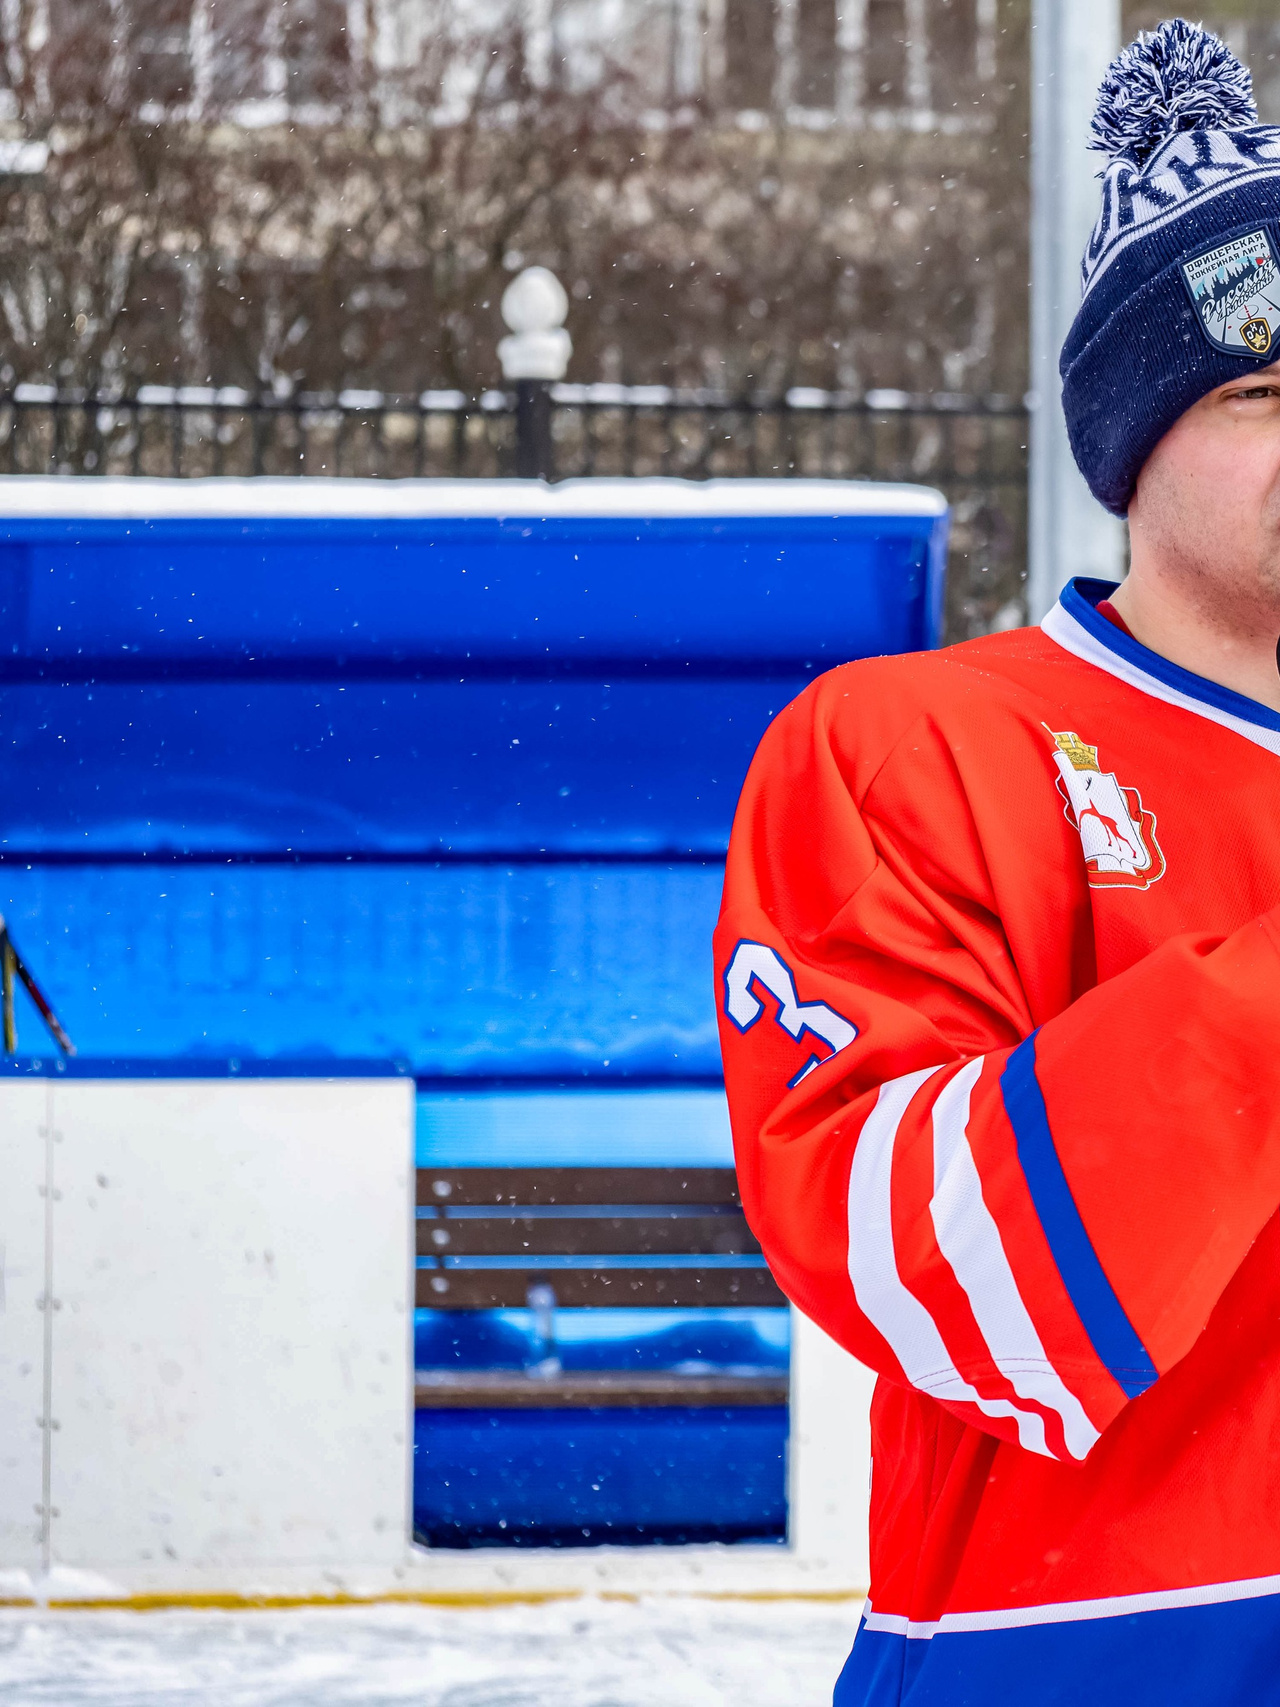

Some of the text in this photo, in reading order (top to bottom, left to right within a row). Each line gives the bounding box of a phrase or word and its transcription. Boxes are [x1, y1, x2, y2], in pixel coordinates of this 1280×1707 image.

[1186, 232, 1263, 273] ОФИЦЕРСКАЯ
[1190, 242, 1266, 281] ХОККЕЙНАЯ ЛИГА
[722, 937, 860, 1090] 3
